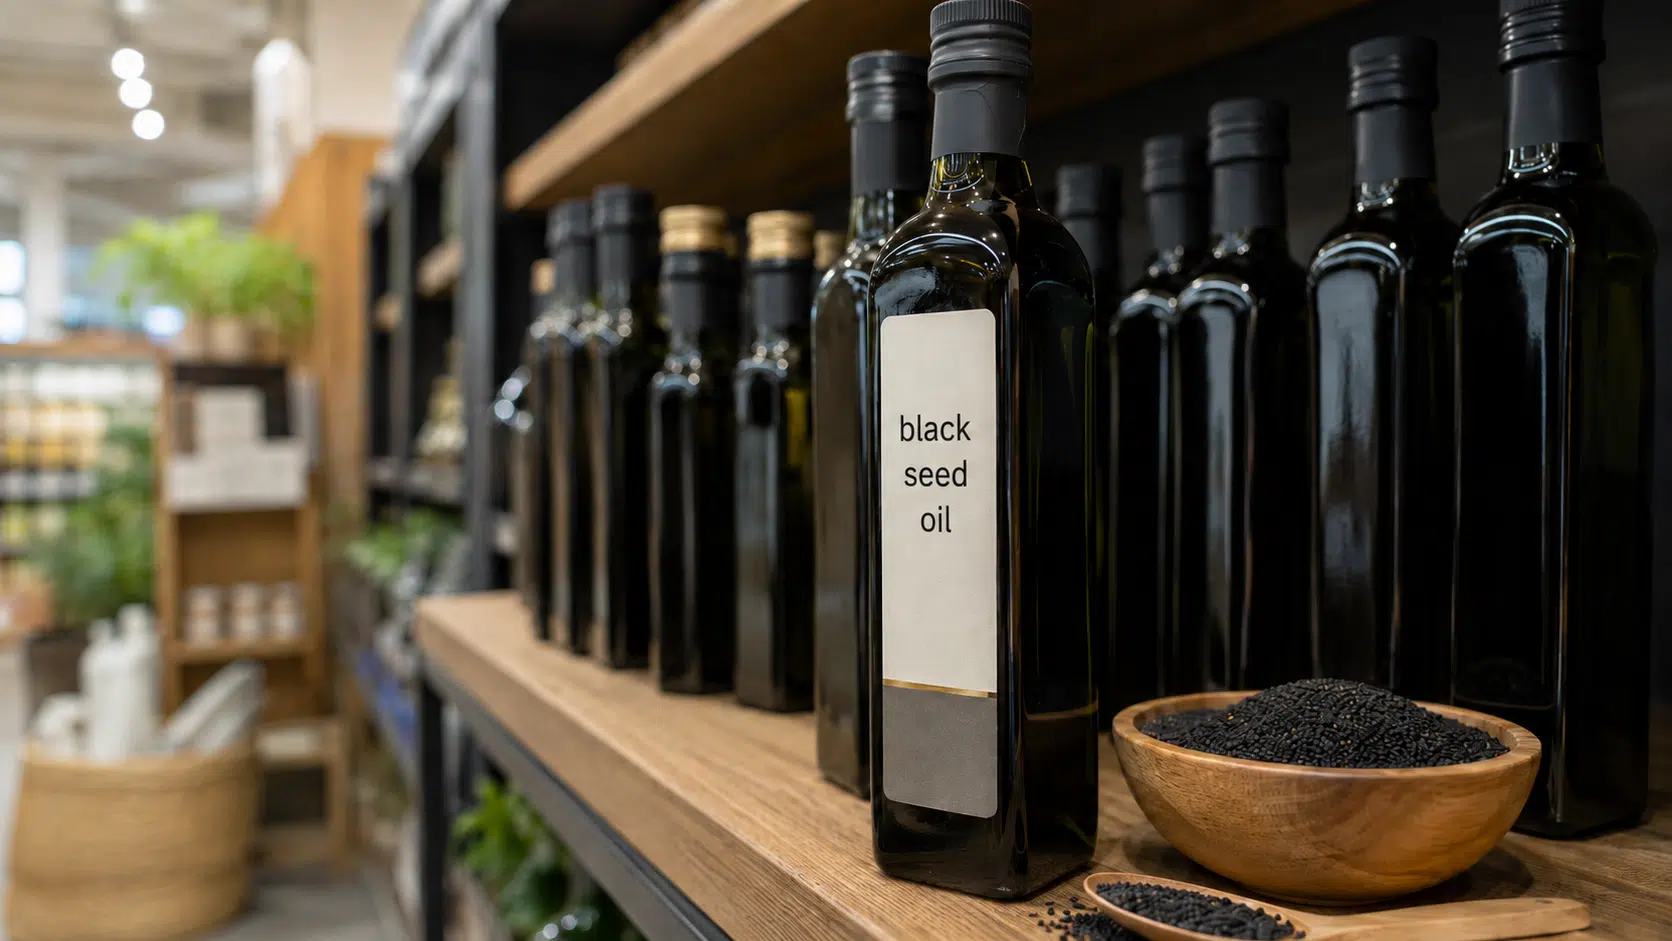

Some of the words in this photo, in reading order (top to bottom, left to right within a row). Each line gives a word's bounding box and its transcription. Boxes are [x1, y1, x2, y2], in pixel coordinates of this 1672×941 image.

[900, 413, 971, 442] black
[904, 459, 967, 487] seed
[920, 505, 952, 533] oil
